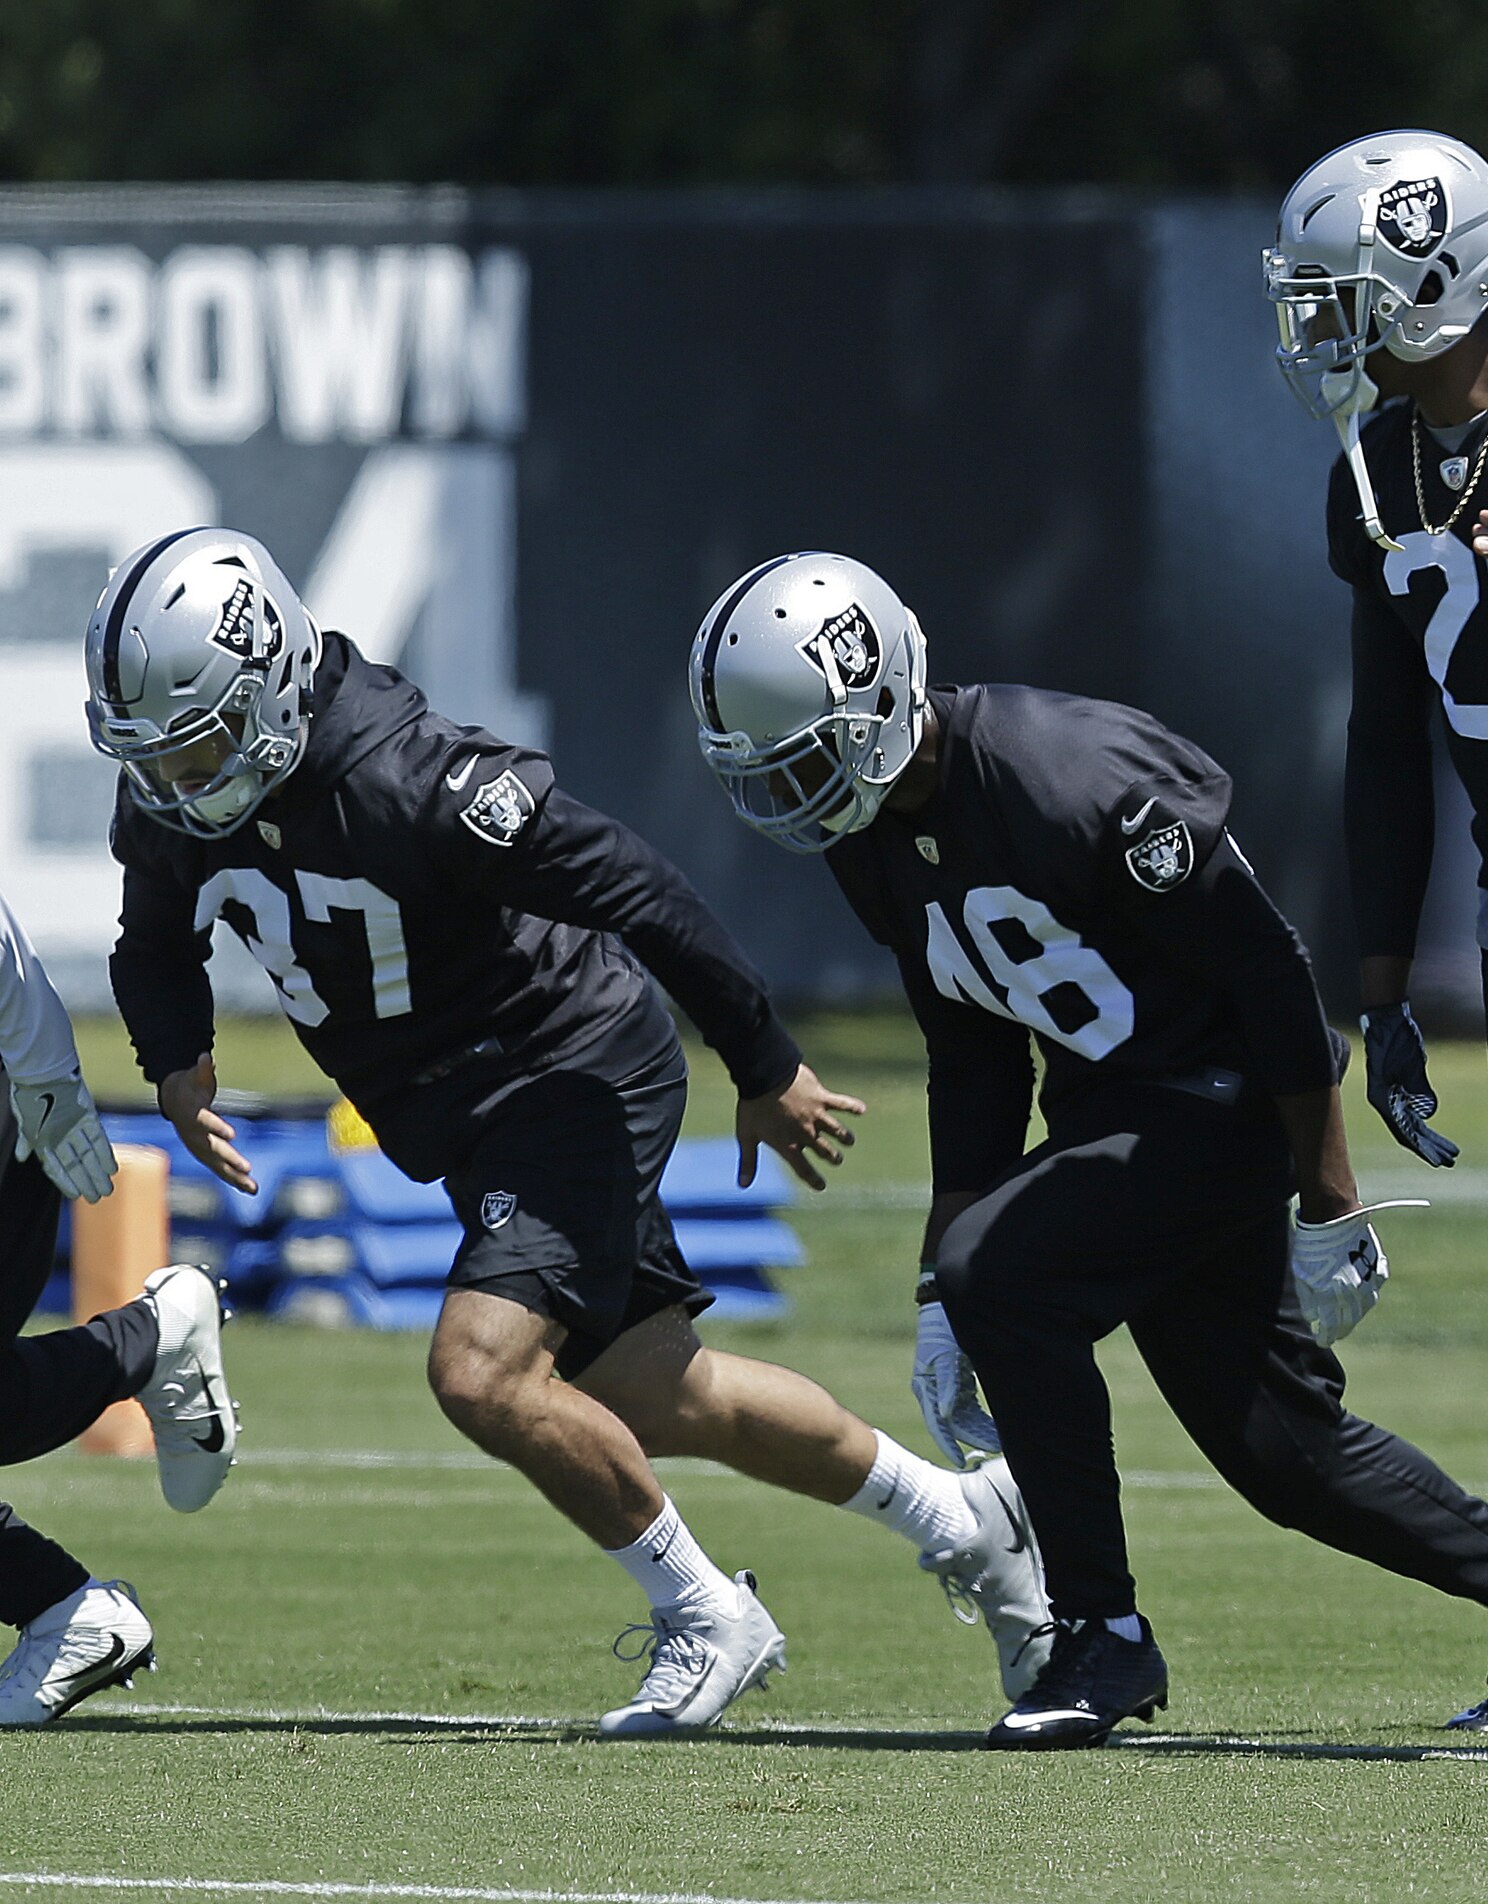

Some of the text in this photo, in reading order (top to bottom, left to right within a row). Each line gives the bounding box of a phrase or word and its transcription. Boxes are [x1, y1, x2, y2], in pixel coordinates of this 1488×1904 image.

[1376, 179, 1436, 205] AIDERS
[218, 582, 248, 640] RAIDERS
[808, 606, 858, 653] RIDERS
[194, 868, 412, 1027] 37
